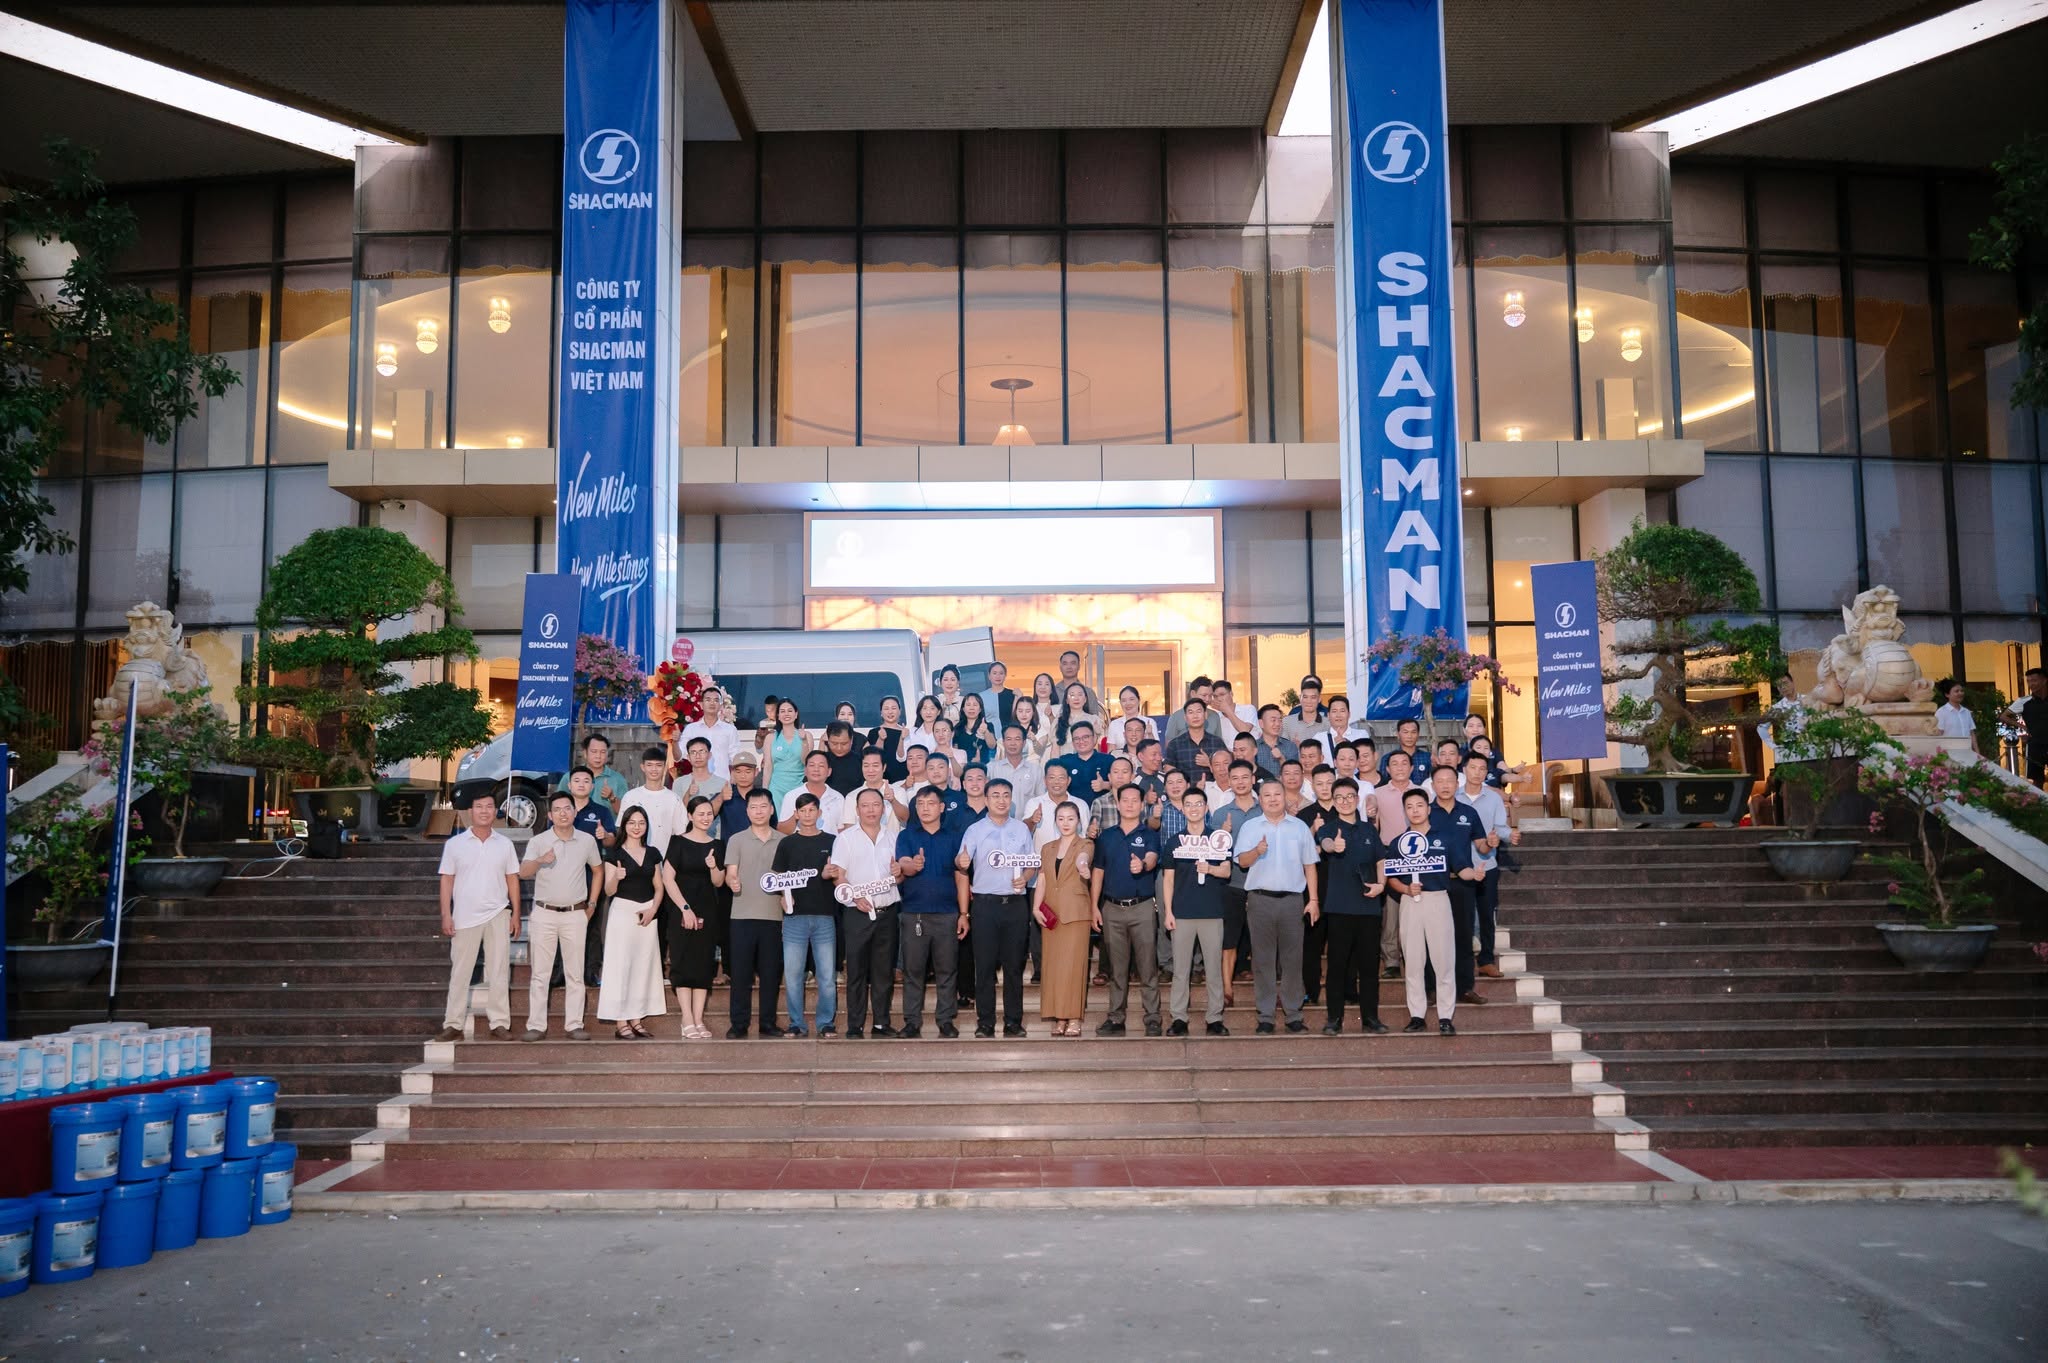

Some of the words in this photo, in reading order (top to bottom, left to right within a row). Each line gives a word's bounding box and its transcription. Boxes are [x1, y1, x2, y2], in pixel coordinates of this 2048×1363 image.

[568, 192, 652, 209] SHACMAN
[576, 278, 619, 300] CÔNG
[624, 280, 641, 299] TY
[574, 305, 596, 330] CỔ
[600, 304, 642, 329] PHẦN
[569, 341, 646, 360] SHACMAN
[571, 369, 604, 394] VIỆT
[609, 371, 643, 390] NAM
[1377, 252, 1441, 611] SHACMAN
[563, 451, 597, 526] New
[596, 471, 638, 520] Miles
[592, 550, 650, 602] Milestones
[1544, 629, 1590, 639] SHACMAN
[517, 689, 538, 709] New
[536, 694, 563, 708] Miles
[1542, 679, 1564, 700] New
[1563, 682, 1592, 697] Miles
[1547, 706, 1564, 719] New
[1563, 704, 1601, 717] Milestones
[520, 716, 535, 728] New
[534, 716, 568, 730] Milestones
[1179, 836, 1209, 847] VUA
[1384, 856, 1444, 867] SHACMAN
